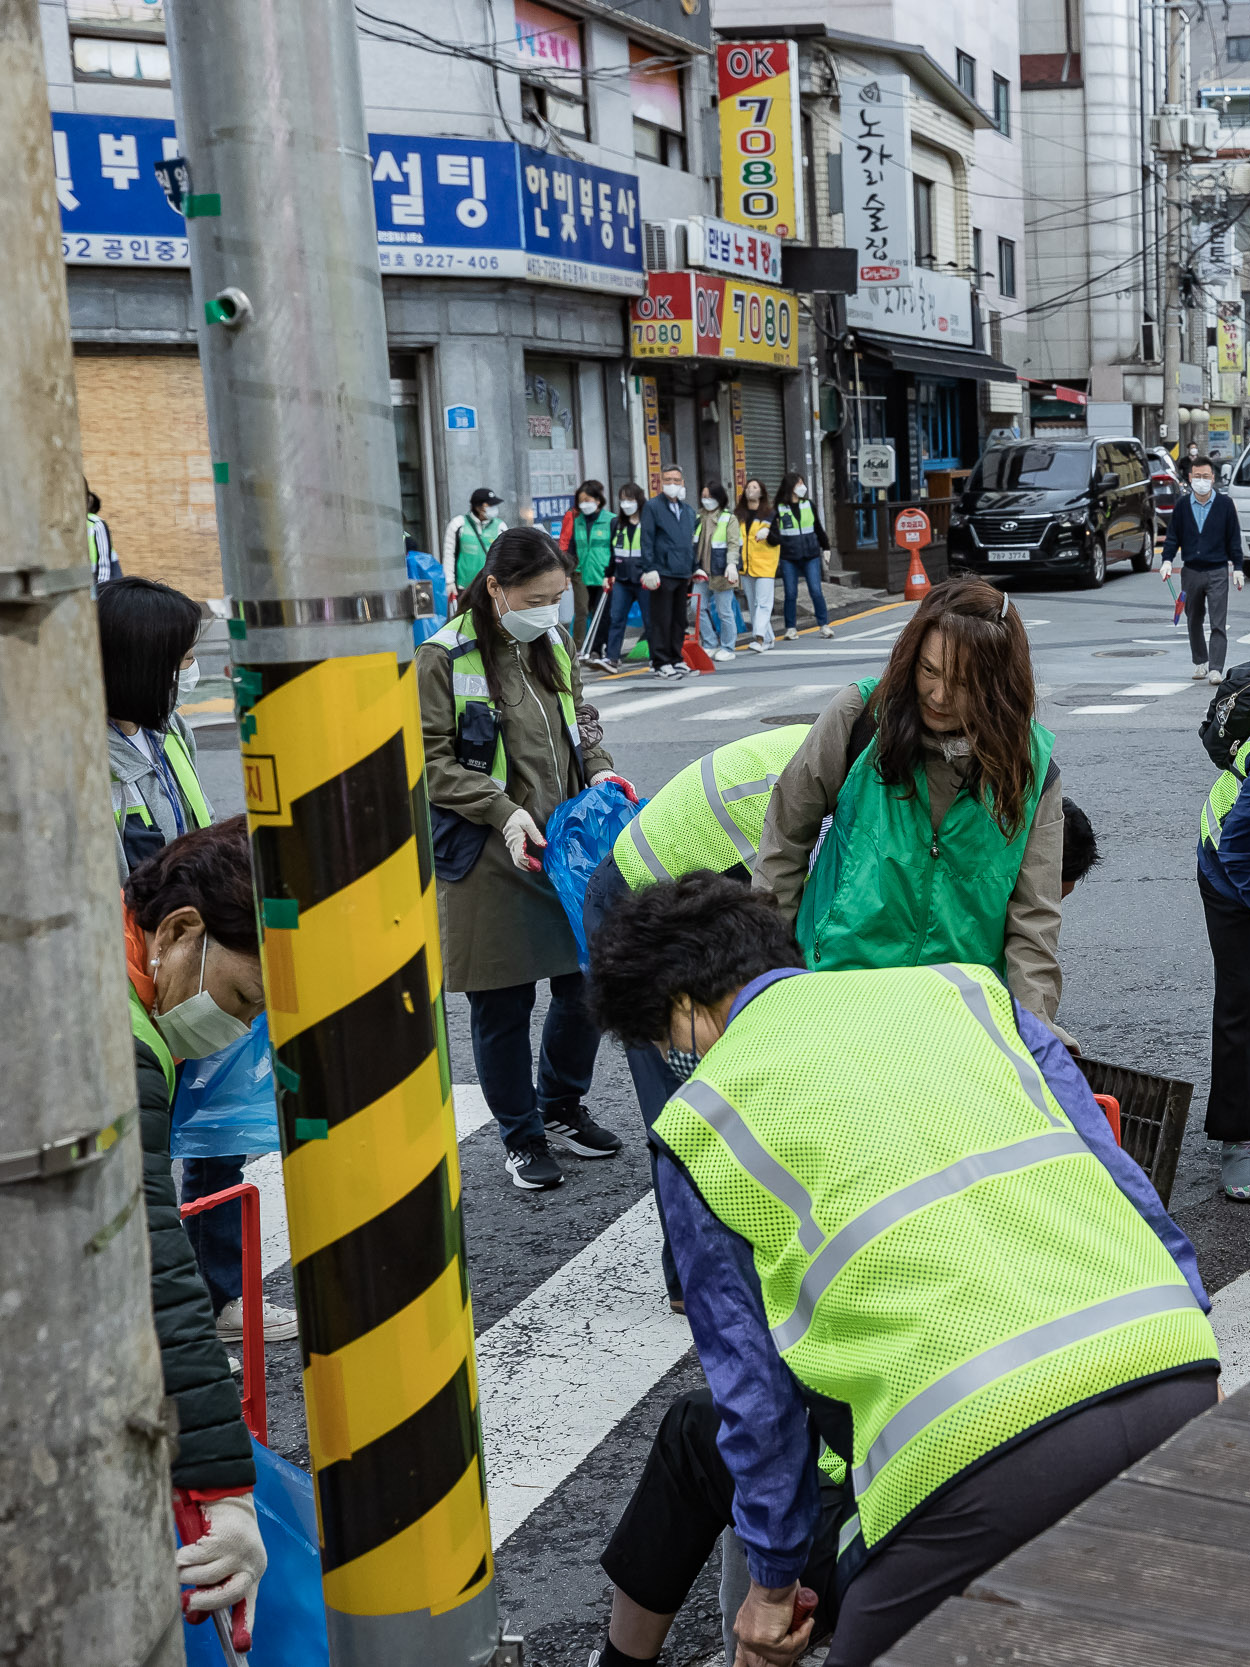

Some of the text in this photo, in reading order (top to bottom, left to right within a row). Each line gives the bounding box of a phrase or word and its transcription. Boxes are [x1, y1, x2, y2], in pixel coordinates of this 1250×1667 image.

[727, 48, 776, 79] OK
[736, 96, 778, 219] 7080
[525, 165, 637, 255] 한빛부동산
[414, 252, 500, 270] 9227-406
[708, 228, 771, 275] 만남노래방
[636, 295, 675, 320] OK
[696, 287, 791, 349] OK 7080
[632, 324, 682, 345] 7080
